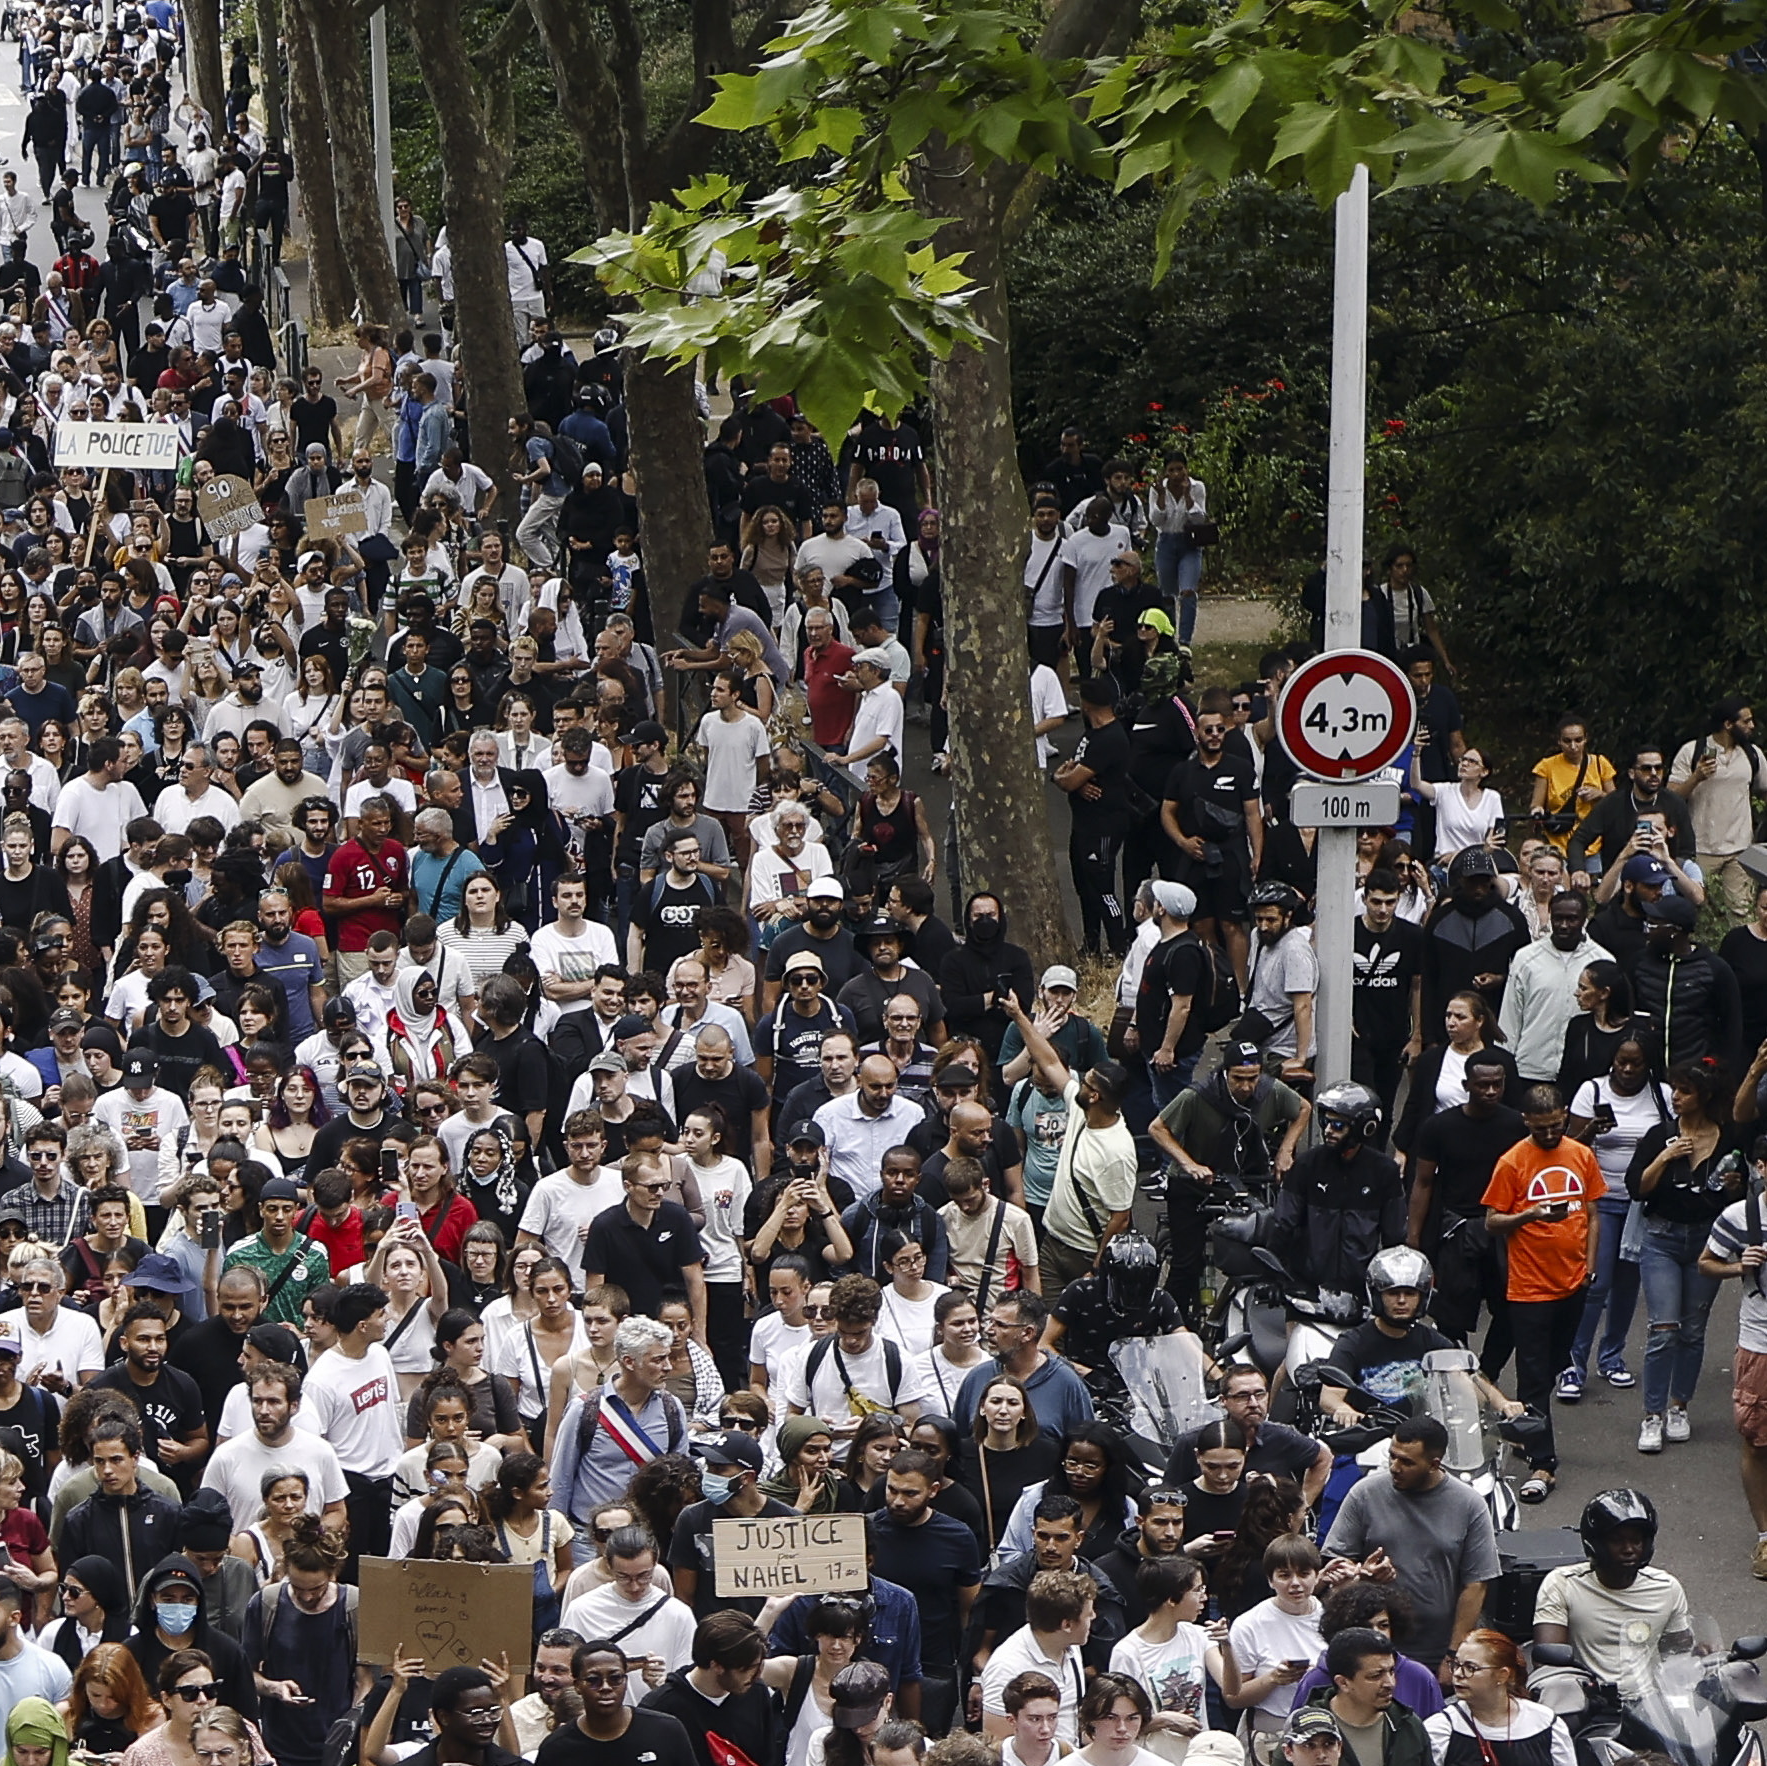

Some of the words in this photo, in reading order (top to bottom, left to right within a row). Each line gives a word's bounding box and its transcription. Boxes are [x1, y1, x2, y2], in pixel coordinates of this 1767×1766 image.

[57, 433, 77, 455] LA
[88, 432, 143, 457] POLICE
[146, 432, 177, 458] TUE
[1306, 703, 1388, 737] 4,3m
[1322, 797, 1351, 819] 100
[1356, 803, 1372, 818] m
[358, 870, 375, 890] 12
[738, 1519, 844, 1552] JUSTICE
[778, 1552, 800, 1564] pour
[824, 1561, 843, 1581] 17
